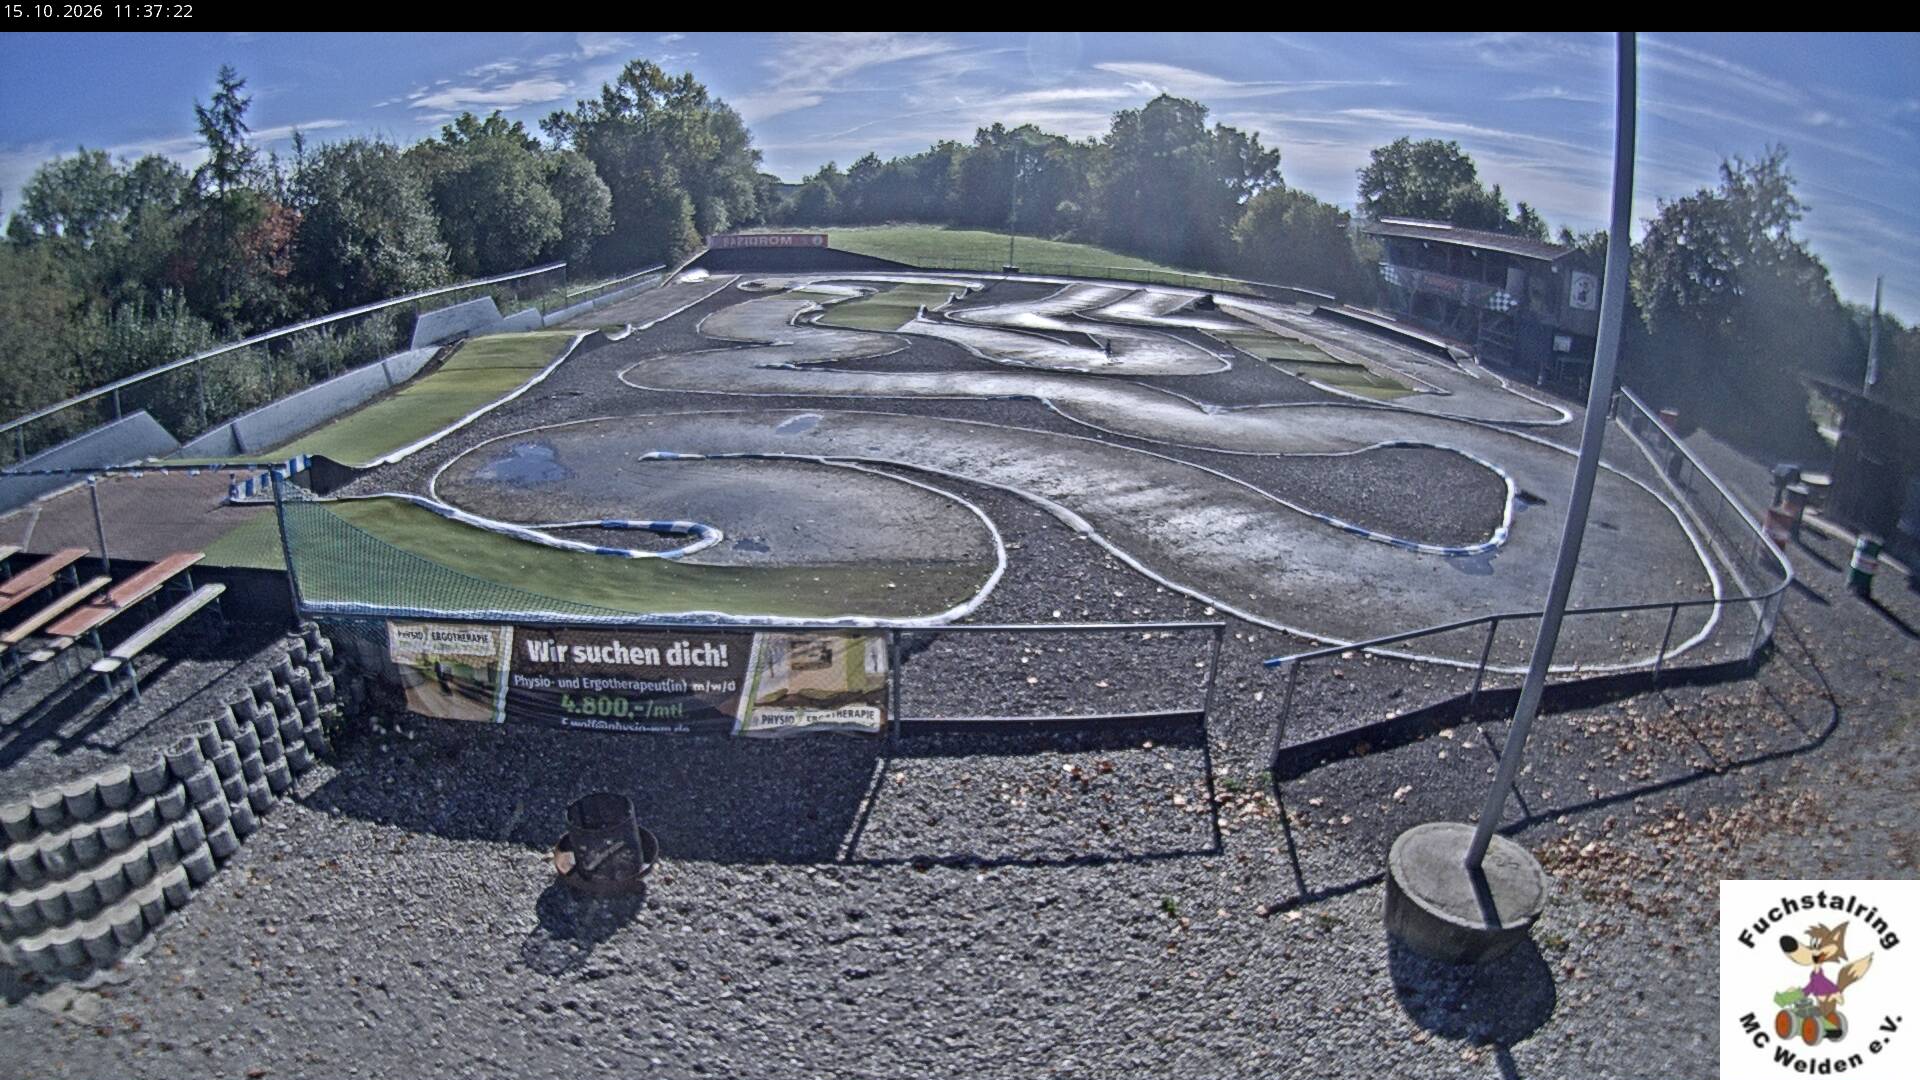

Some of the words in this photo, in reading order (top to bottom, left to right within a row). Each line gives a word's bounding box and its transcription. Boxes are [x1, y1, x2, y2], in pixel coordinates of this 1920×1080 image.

[527, 639, 568, 663] Wir
[574, 640, 658, 666] suchen
[666, 641, 728, 667] dich!
[514, 674, 555, 689] Physio-
[558, 677, 580, 689] und
[583, 677, 687, 694] Ergotherapeut(in)
[692, 680, 736, 692] m/w/d
[761, 714, 795, 725] PHYSIO
